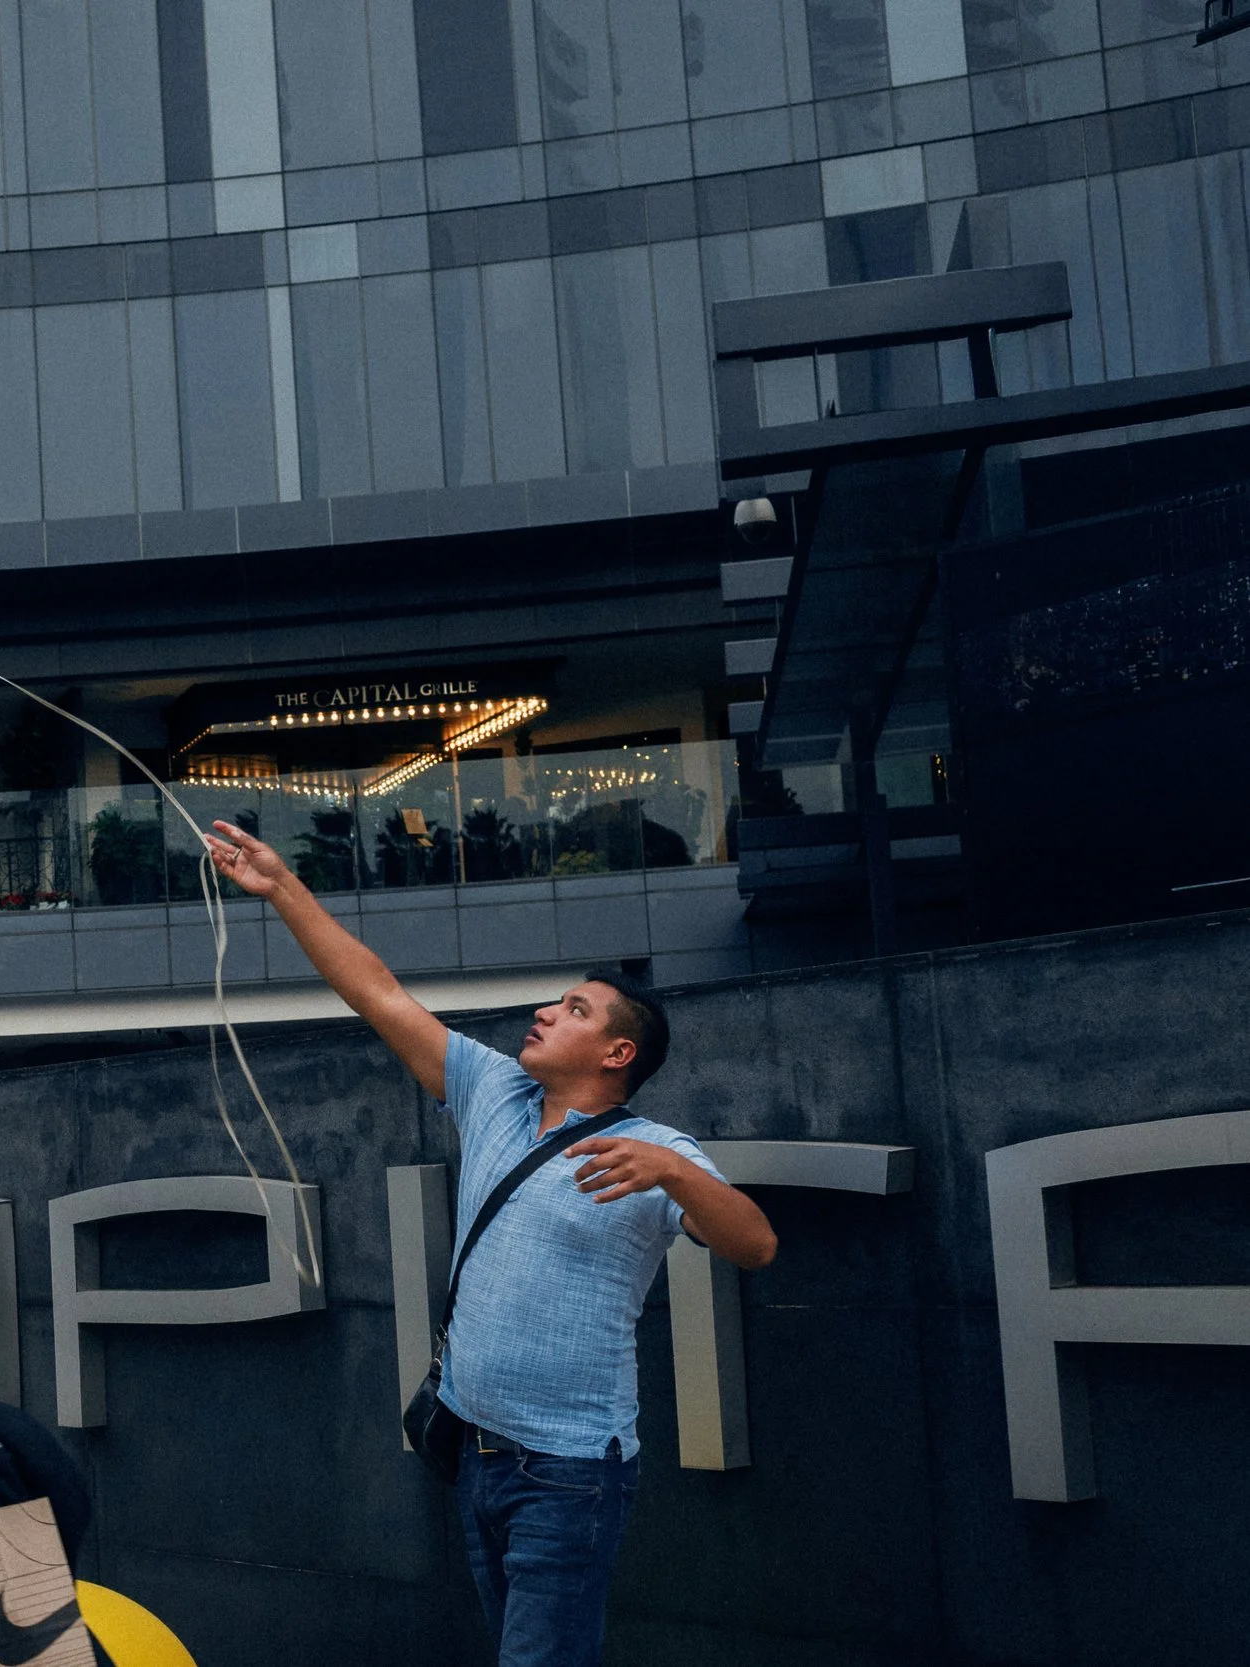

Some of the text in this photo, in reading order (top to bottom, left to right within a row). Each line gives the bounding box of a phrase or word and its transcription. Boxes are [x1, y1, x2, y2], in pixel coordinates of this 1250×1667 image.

[275, 680, 477, 708] THE CAPITAL GRILLE
